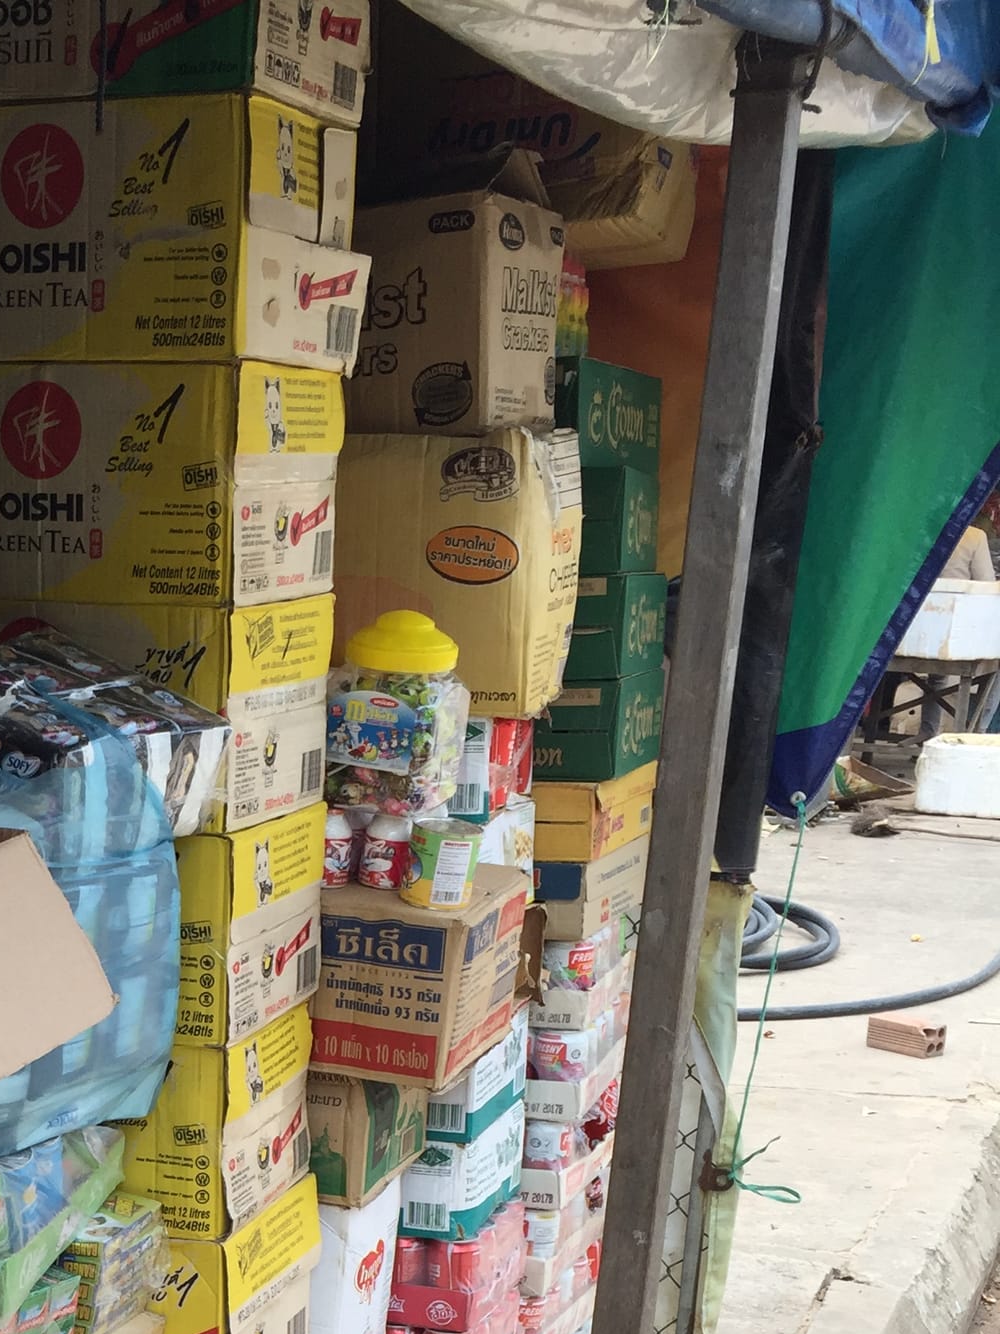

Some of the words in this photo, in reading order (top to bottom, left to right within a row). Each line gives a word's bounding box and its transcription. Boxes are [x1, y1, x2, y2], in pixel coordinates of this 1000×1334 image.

[158, 117, 191, 185] 1
[123, 176, 155, 196] Best
[0, 241, 87, 274] OISHI
[46, 281, 89, 309] TEA
[135, 315, 151, 330] Net
[152, 314, 188, 331] Content
[189, 314, 201, 329] 12
[202, 314, 227, 329] litres
[153, 383, 186, 444] 1
[119, 435, 151, 453] Best
[104, 456, 154, 478] Selling
[0, 491, 84, 522] OISHI
[44, 529, 87, 555] TEA
[131, 564, 148, 579] Net
[149, 563, 184, 581] Content
[186, 566, 197, 580] 12
[198, 565, 221, 581] litres
[181, 645, 207, 689] 1
[326, 972, 385, 1000] น้ำหนักสุทธิ
[389, 984, 412, 1001] 155
[416, 987, 442, 1004] กรัม
[180, 1011, 191, 1023] 12
[191, 1008, 215, 1024] litres
[394, 1004, 410, 1020] 93
[414, 1007, 440, 1024] กรัม
[324, 1034, 338, 1056] 10
[375, 1043, 389, 1065] 10
[177, 1206, 188, 1219] 12
[188, 1206, 211, 1220] litres
